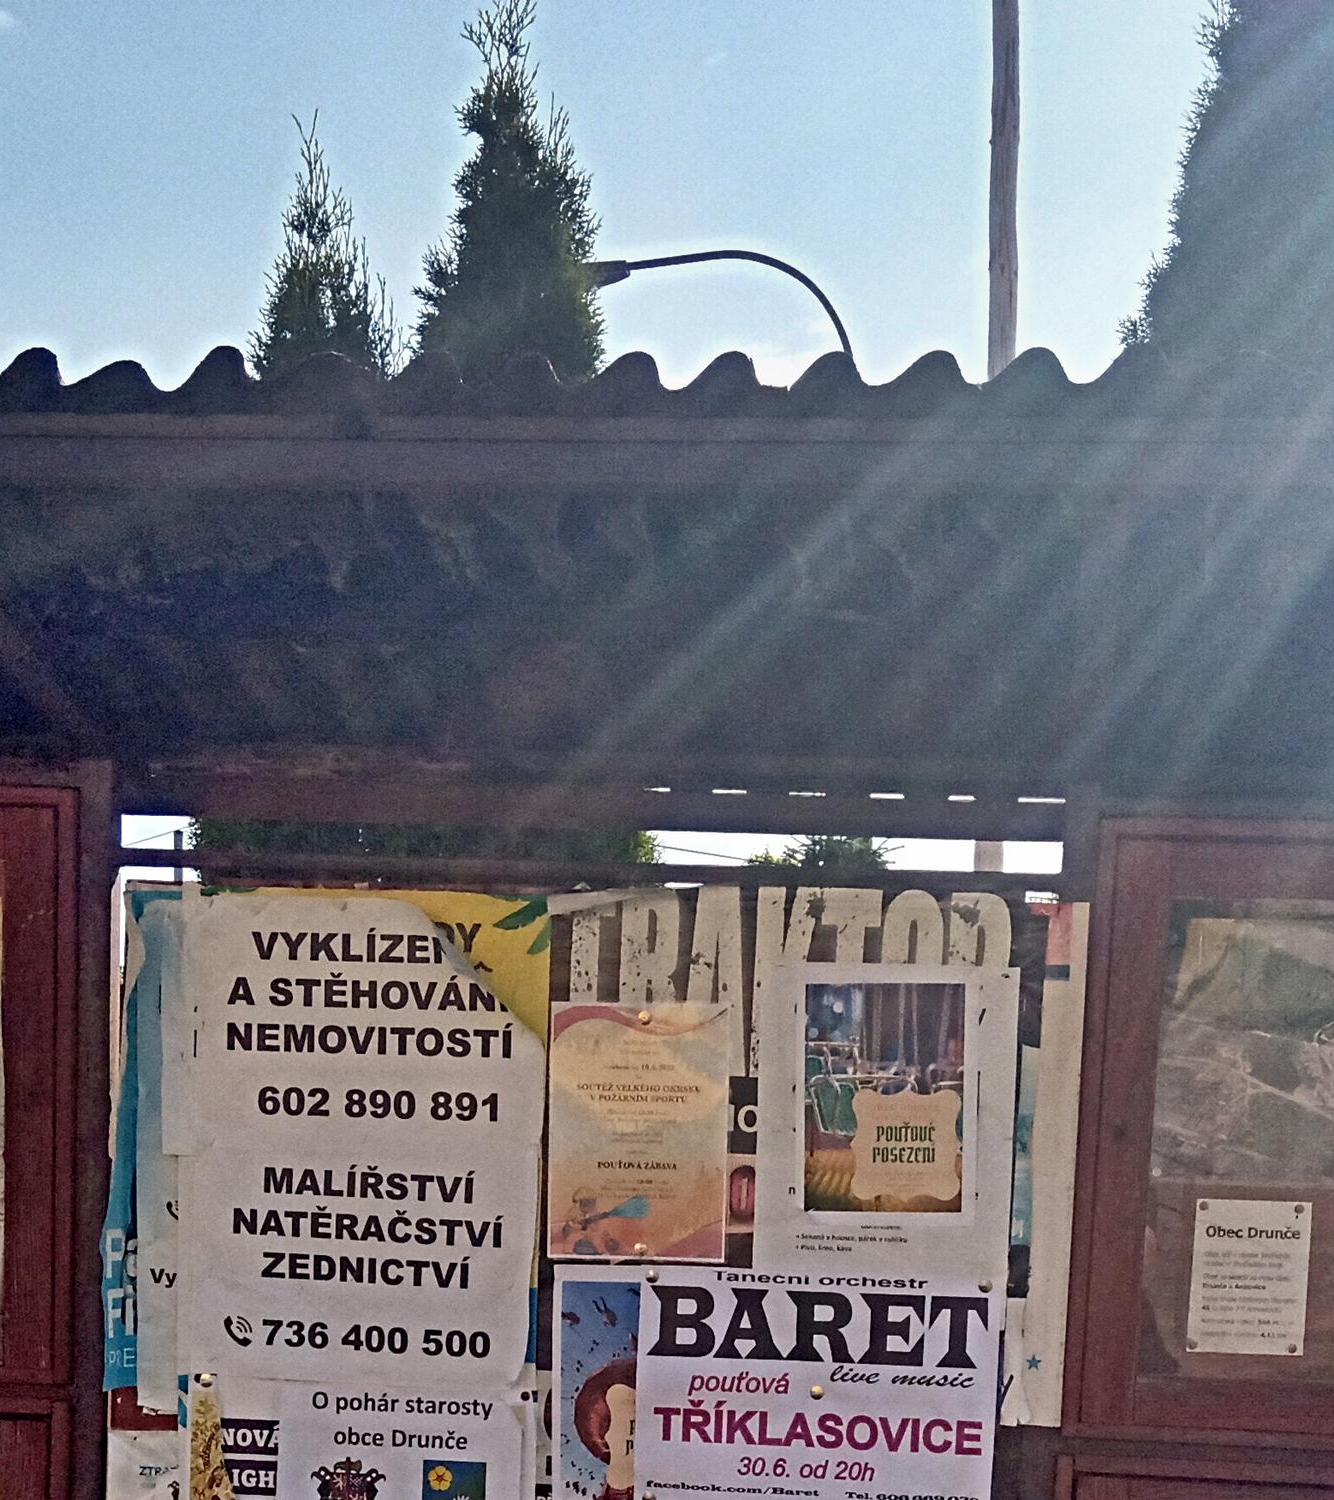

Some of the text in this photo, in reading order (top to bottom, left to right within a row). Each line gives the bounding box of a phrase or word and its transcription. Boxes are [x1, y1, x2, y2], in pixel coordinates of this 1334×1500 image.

[228, 977, 255, 1006] A
[226, 1022, 513, 1059] NEMOVITOSTÍ
[258, 1087, 500, 1122] 602 890 891
[263, 1165, 475, 1205] MALÍŘSTVÍ
[233, 1205, 504, 1249] NATĚRAČSTVÍ
[1206, 1225, 1301, 1240] Obec Drunče
[150, 1268, 177, 1288] Vy
[261, 1252, 470, 1290] ZEDNICTVÍ
[819, 1277, 928, 1289] orchestr
[262, 1319, 492, 1359] 736 400 500
[646, 1285, 989, 1369] BARET
[687, 1371, 790, 1397] pouťová
[830, 1365, 975, 1388] live music
[312, 1392, 493, 1421] O pohár starosty
[334, 1427, 467, 1450] obce Drunče
[654, 1400, 983, 1456] TŘÍKLASOVICE
[737, 1457, 875, 1482] 30.6. od 20h
[646, 1480, 820, 1497] facebook.com/Baret
[845, 1491, 873, 1500] Tel.
